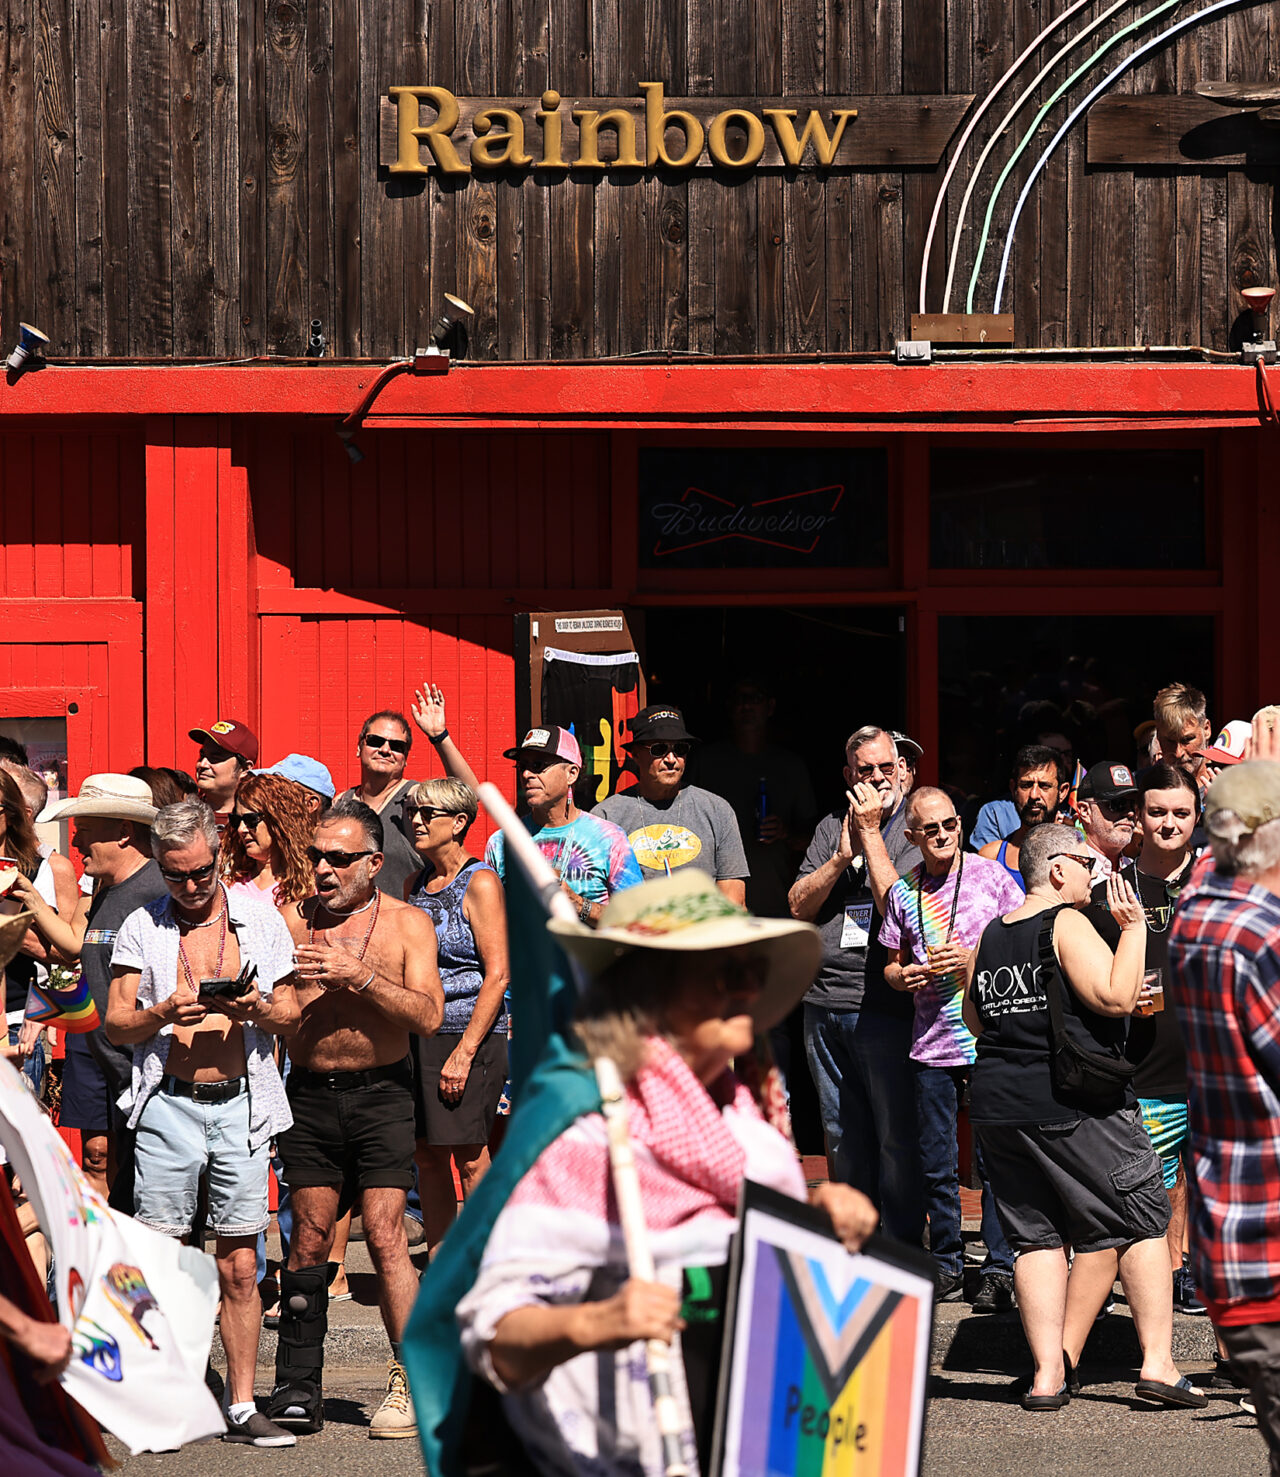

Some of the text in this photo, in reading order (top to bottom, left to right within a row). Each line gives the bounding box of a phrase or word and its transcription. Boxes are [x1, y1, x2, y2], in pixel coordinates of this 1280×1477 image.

[389, 82, 858, 174] Rainbow
[652, 503, 836, 535] Budweiser
[977, 962, 1042, 1002] ROXY
[784, 1384, 868, 1460] People
